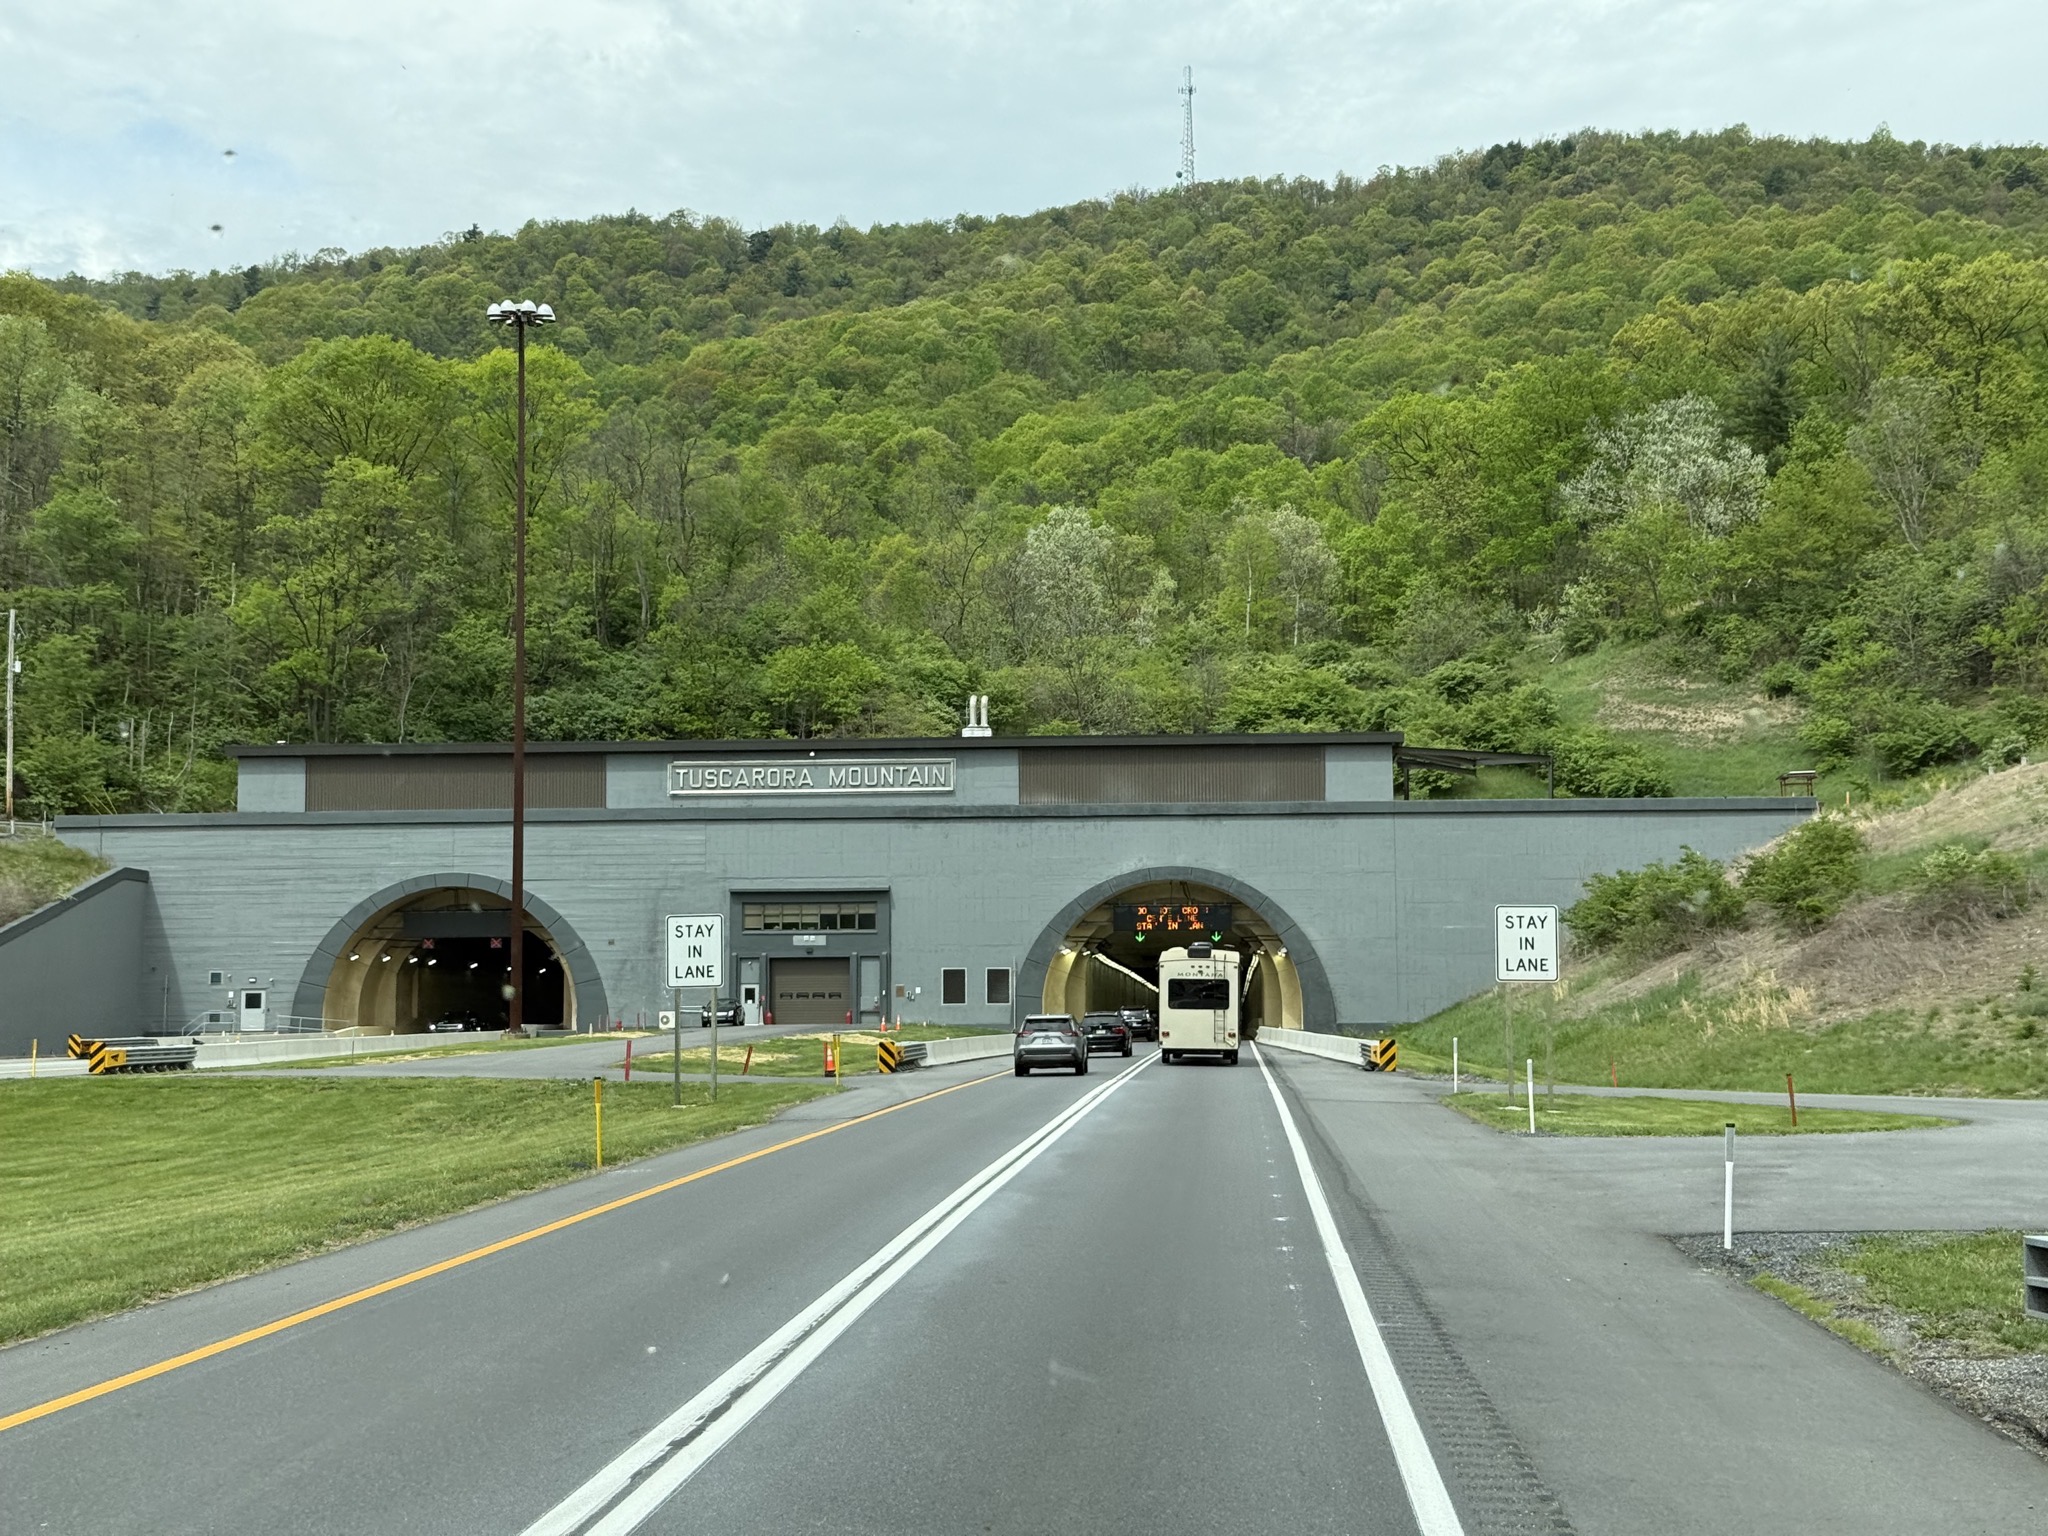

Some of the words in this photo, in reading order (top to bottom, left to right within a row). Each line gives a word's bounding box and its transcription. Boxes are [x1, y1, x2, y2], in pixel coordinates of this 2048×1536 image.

[675, 768, 813, 788] TUSCARORA
[828, 766, 945, 786] MOUNTAIN
[1136, 921, 1158, 931] STA
[1167, 921, 1178, 930] IN
[1505, 915, 1548, 929] STAY
[675, 924, 715, 938] STAY
[1519, 936, 1535, 950] IN
[688, 944, 702, 958] IN
[675, 965, 715, 979] LANE
[1505, 958, 1549, 972] LANE
